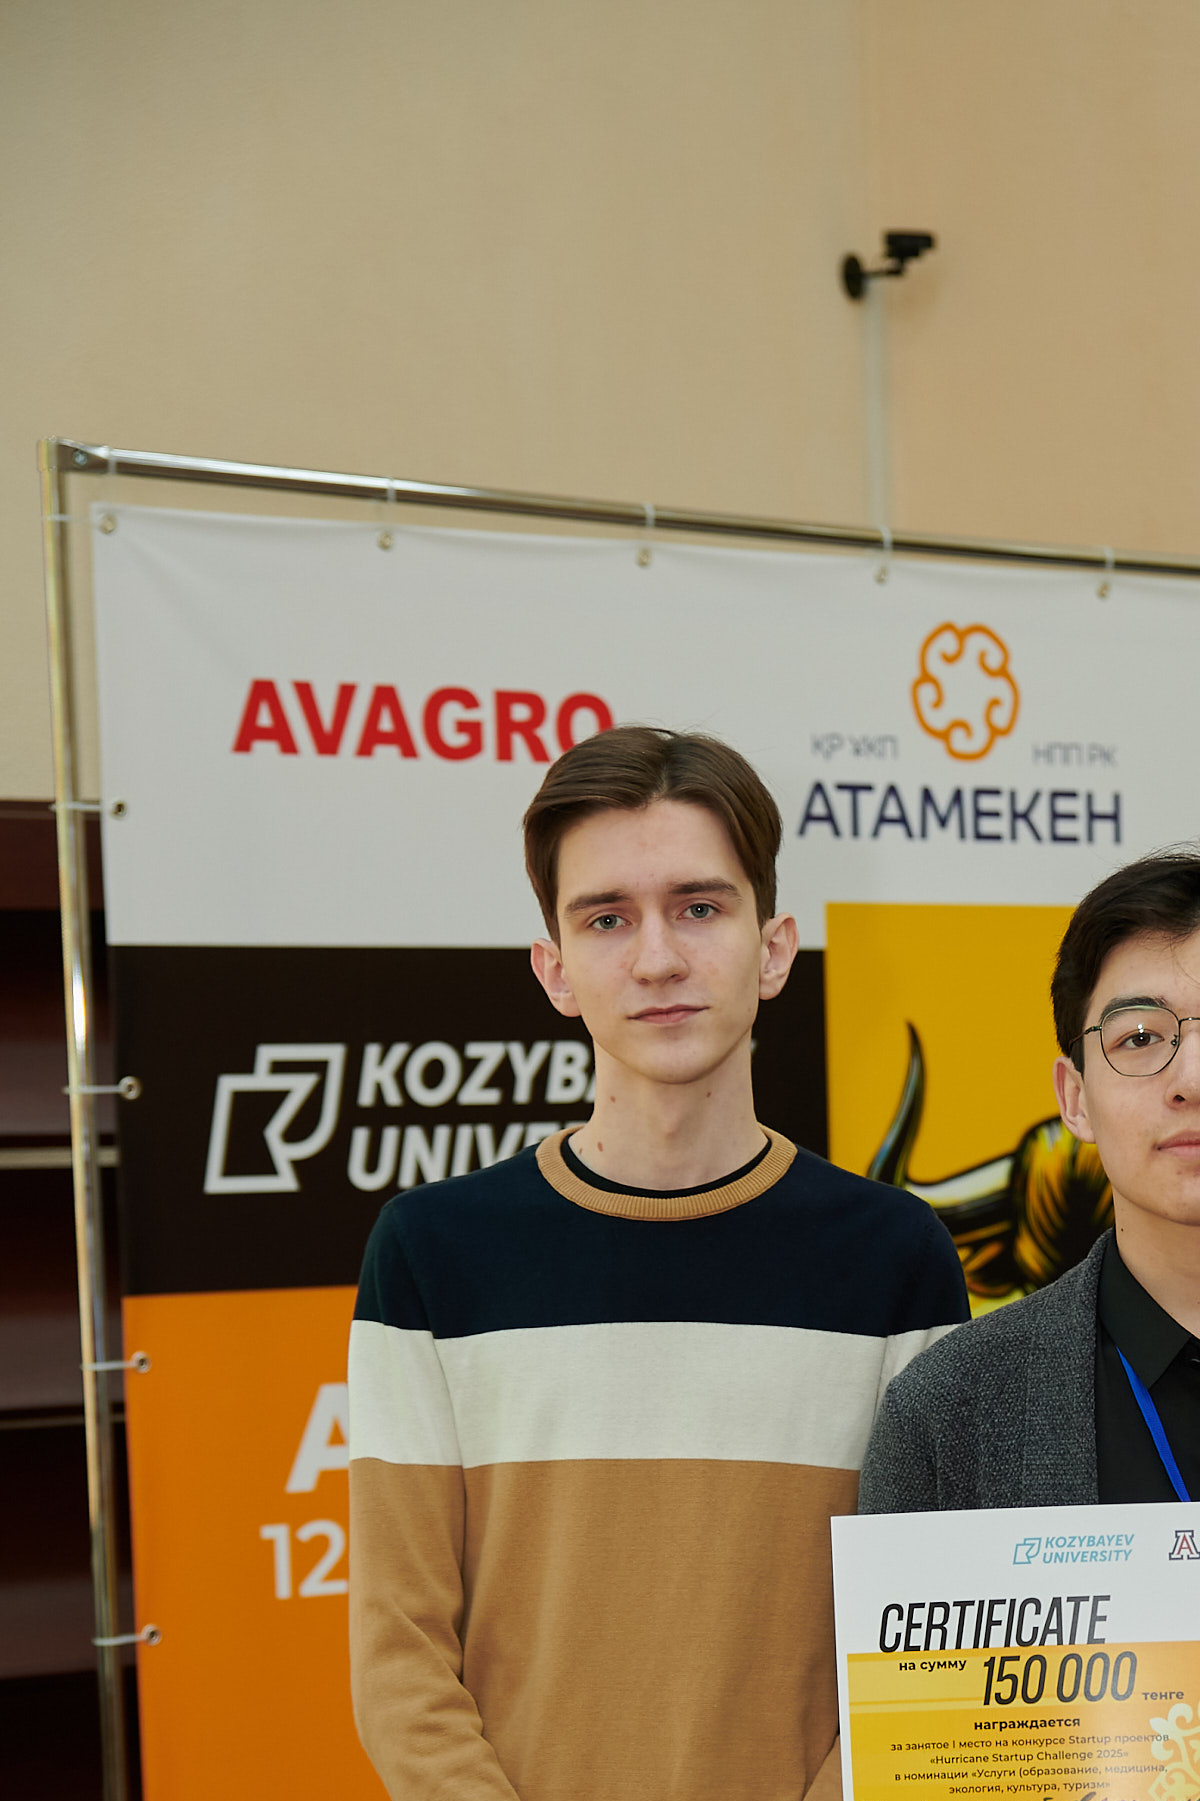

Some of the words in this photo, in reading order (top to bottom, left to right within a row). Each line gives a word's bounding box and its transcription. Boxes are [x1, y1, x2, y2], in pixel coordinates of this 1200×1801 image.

[231, 678, 614, 764] AVAGRO
[798, 780, 1122, 844] АТАМЕКЕН
[357, 1040, 595, 1107] KOZYB
[1045, 1534, 1135, 1549] KOZYBAYEV
[1043, 1550, 1132, 1564] UNIVERSITY
[879, 1595, 1111, 1653] CERTIFICATE
[899, 1660, 916, 1671] на
[920, 1659, 967, 1674] сумму
[983, 1653, 1047, 1706] 150
[1056, 1651, 1138, 1703] 000
[1142, 1690, 1185, 1701] тенге
[974, 1717, 1081, 1732] награждается
[891, 1742, 903, 1751] за
[905, 1740, 949, 1751] занятое
[958, 1739, 992, 1749] место
[995, 1738, 1008, 1747] на
[1011, 1736, 1066, 1749] конкурсе
[1068, 1733, 1112, 1747] Startup
[1114, 1732, 1169, 1746] проектов
[992, 1751, 1034, 1764] Startup
[1036, 1749, 1093, 1762] Challenge
[895, 1772, 901, 1781] в
[904, 1769, 968, 1781] номинации
[1104, 1763, 1169, 1776] медицина,
[949, 1784, 1004, 1796] экология,
[1006, 1781, 1060, 1795] культура,
